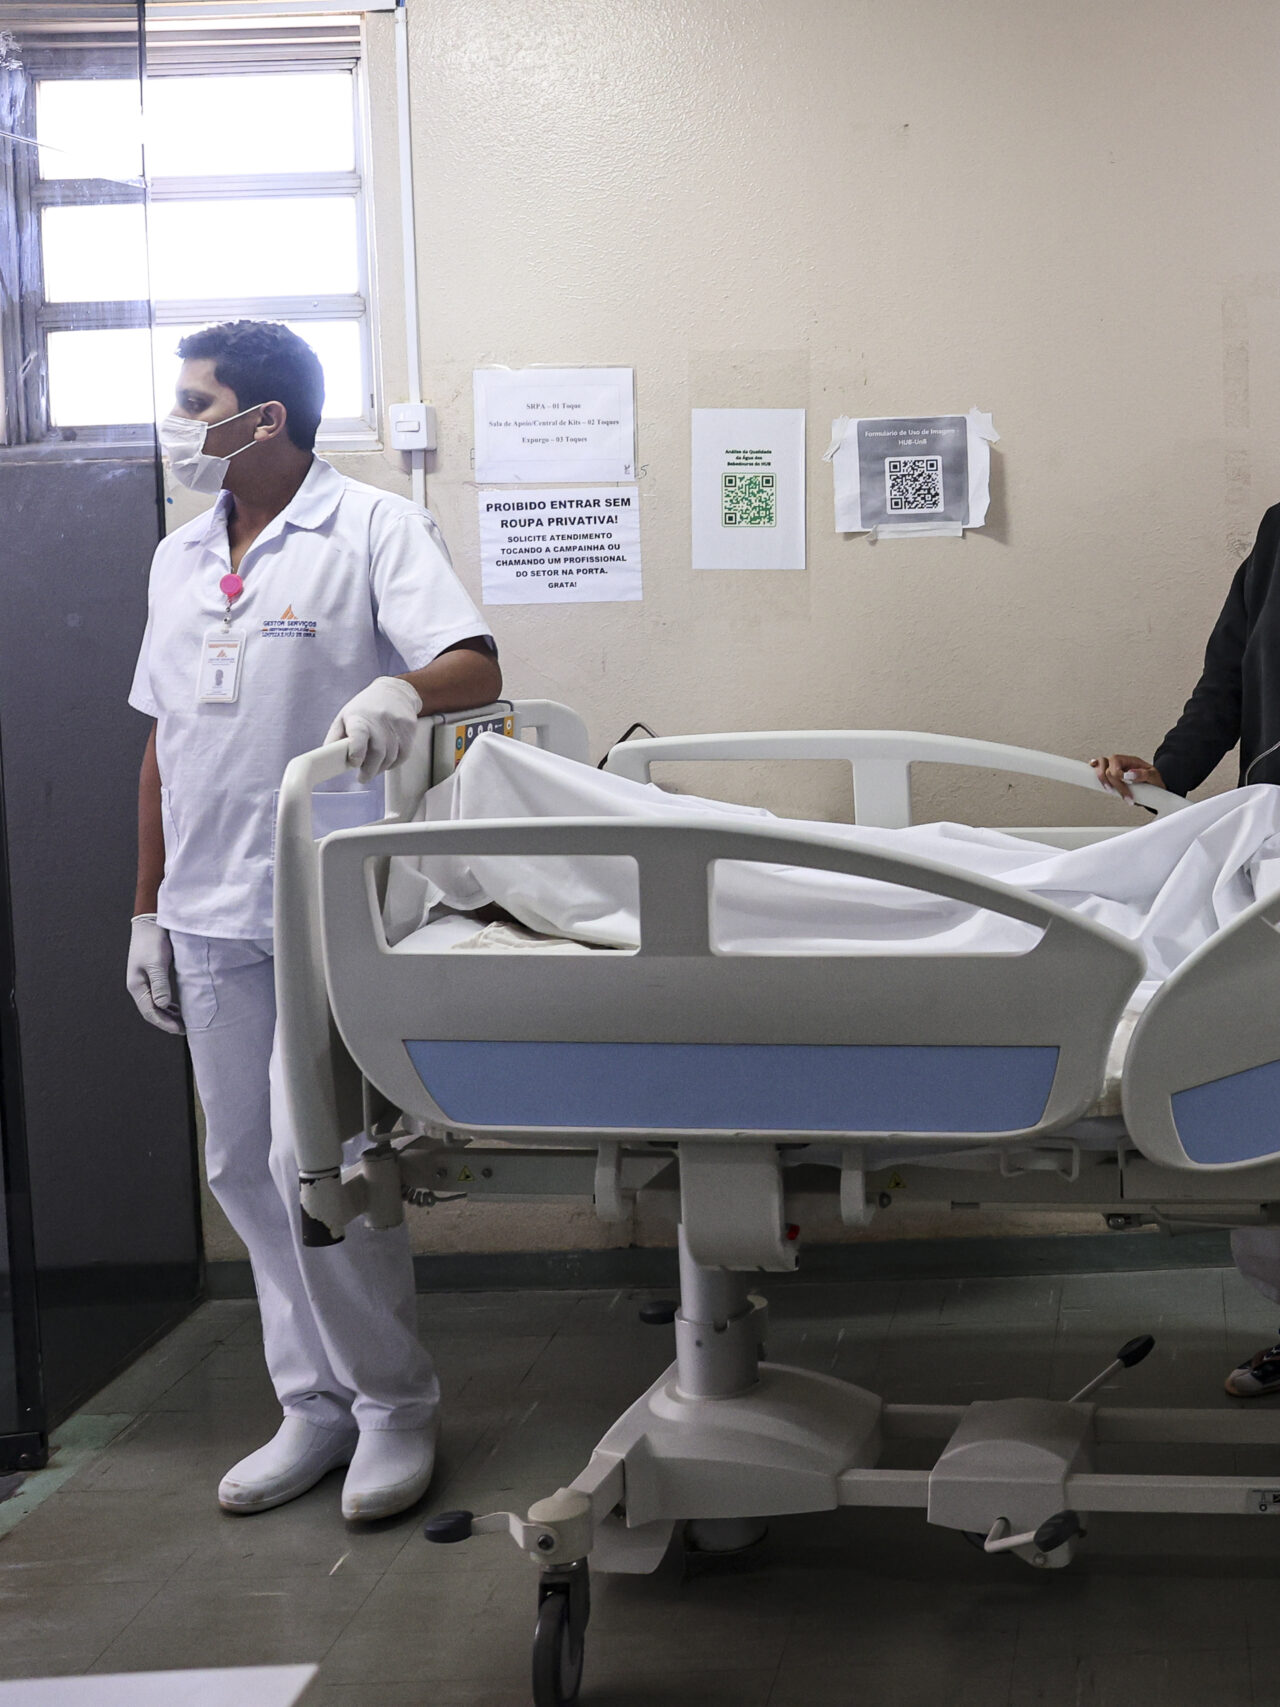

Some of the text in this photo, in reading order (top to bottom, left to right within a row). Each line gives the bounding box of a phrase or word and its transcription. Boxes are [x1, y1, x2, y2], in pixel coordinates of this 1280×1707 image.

[486, 498, 631, 512] PROIBIDO ENTRAR SEM
[501, 515, 618, 528] ROUPA PRIVATIVA!
[550, 532, 612, 541] ATENDIMENTO
[553, 545, 605, 553] CAMPAINHA
[496, 558, 545, 566] CHAMANDO
[564, 555, 627, 564] PROFISSIONAL
